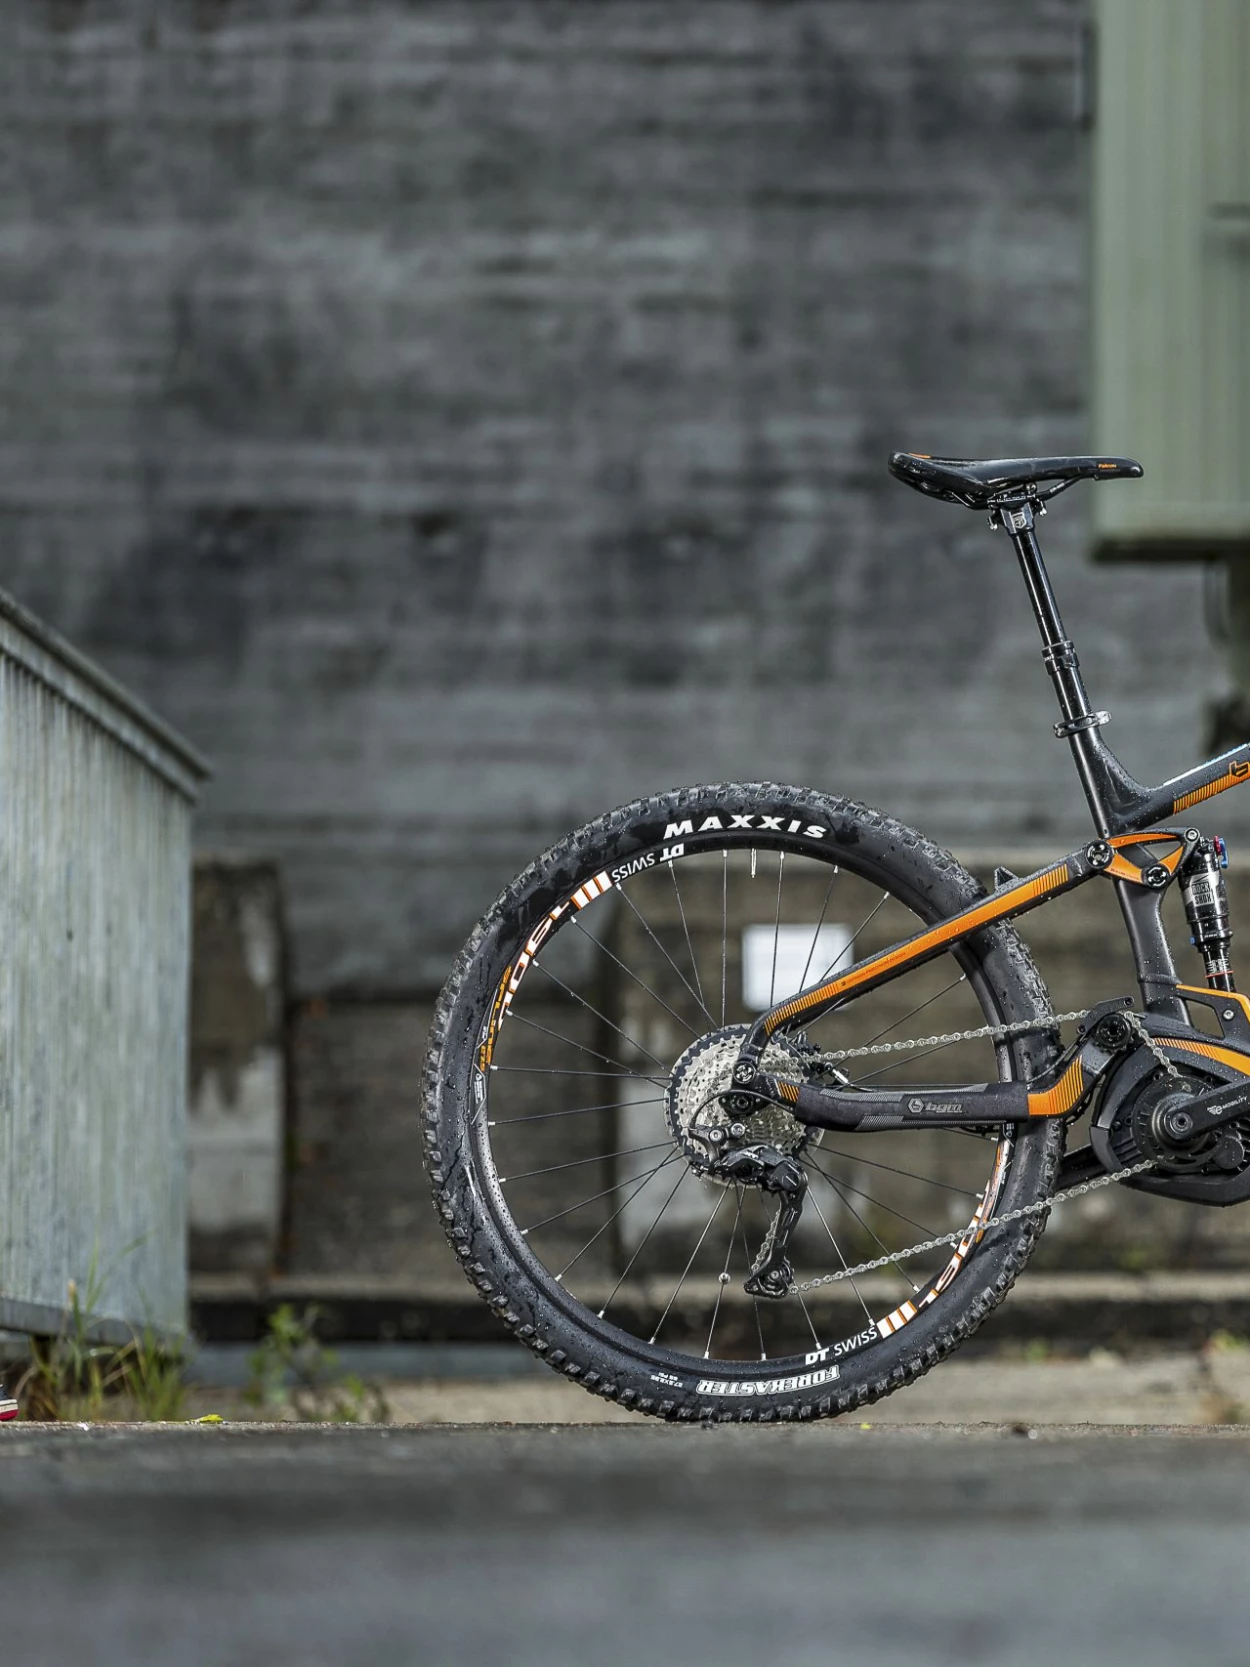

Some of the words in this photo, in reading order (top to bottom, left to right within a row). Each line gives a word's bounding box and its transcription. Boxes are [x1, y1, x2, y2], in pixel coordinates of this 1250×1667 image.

[663, 814, 827, 840] MAXXIS
[611, 852, 655, 884] SWISS
[659, 842, 684, 862] DT
[805, 1347, 830, 1365] DT
[833, 1325, 878, 1357] SWISS
[696, 1364, 841, 1397] FOREKASTER
